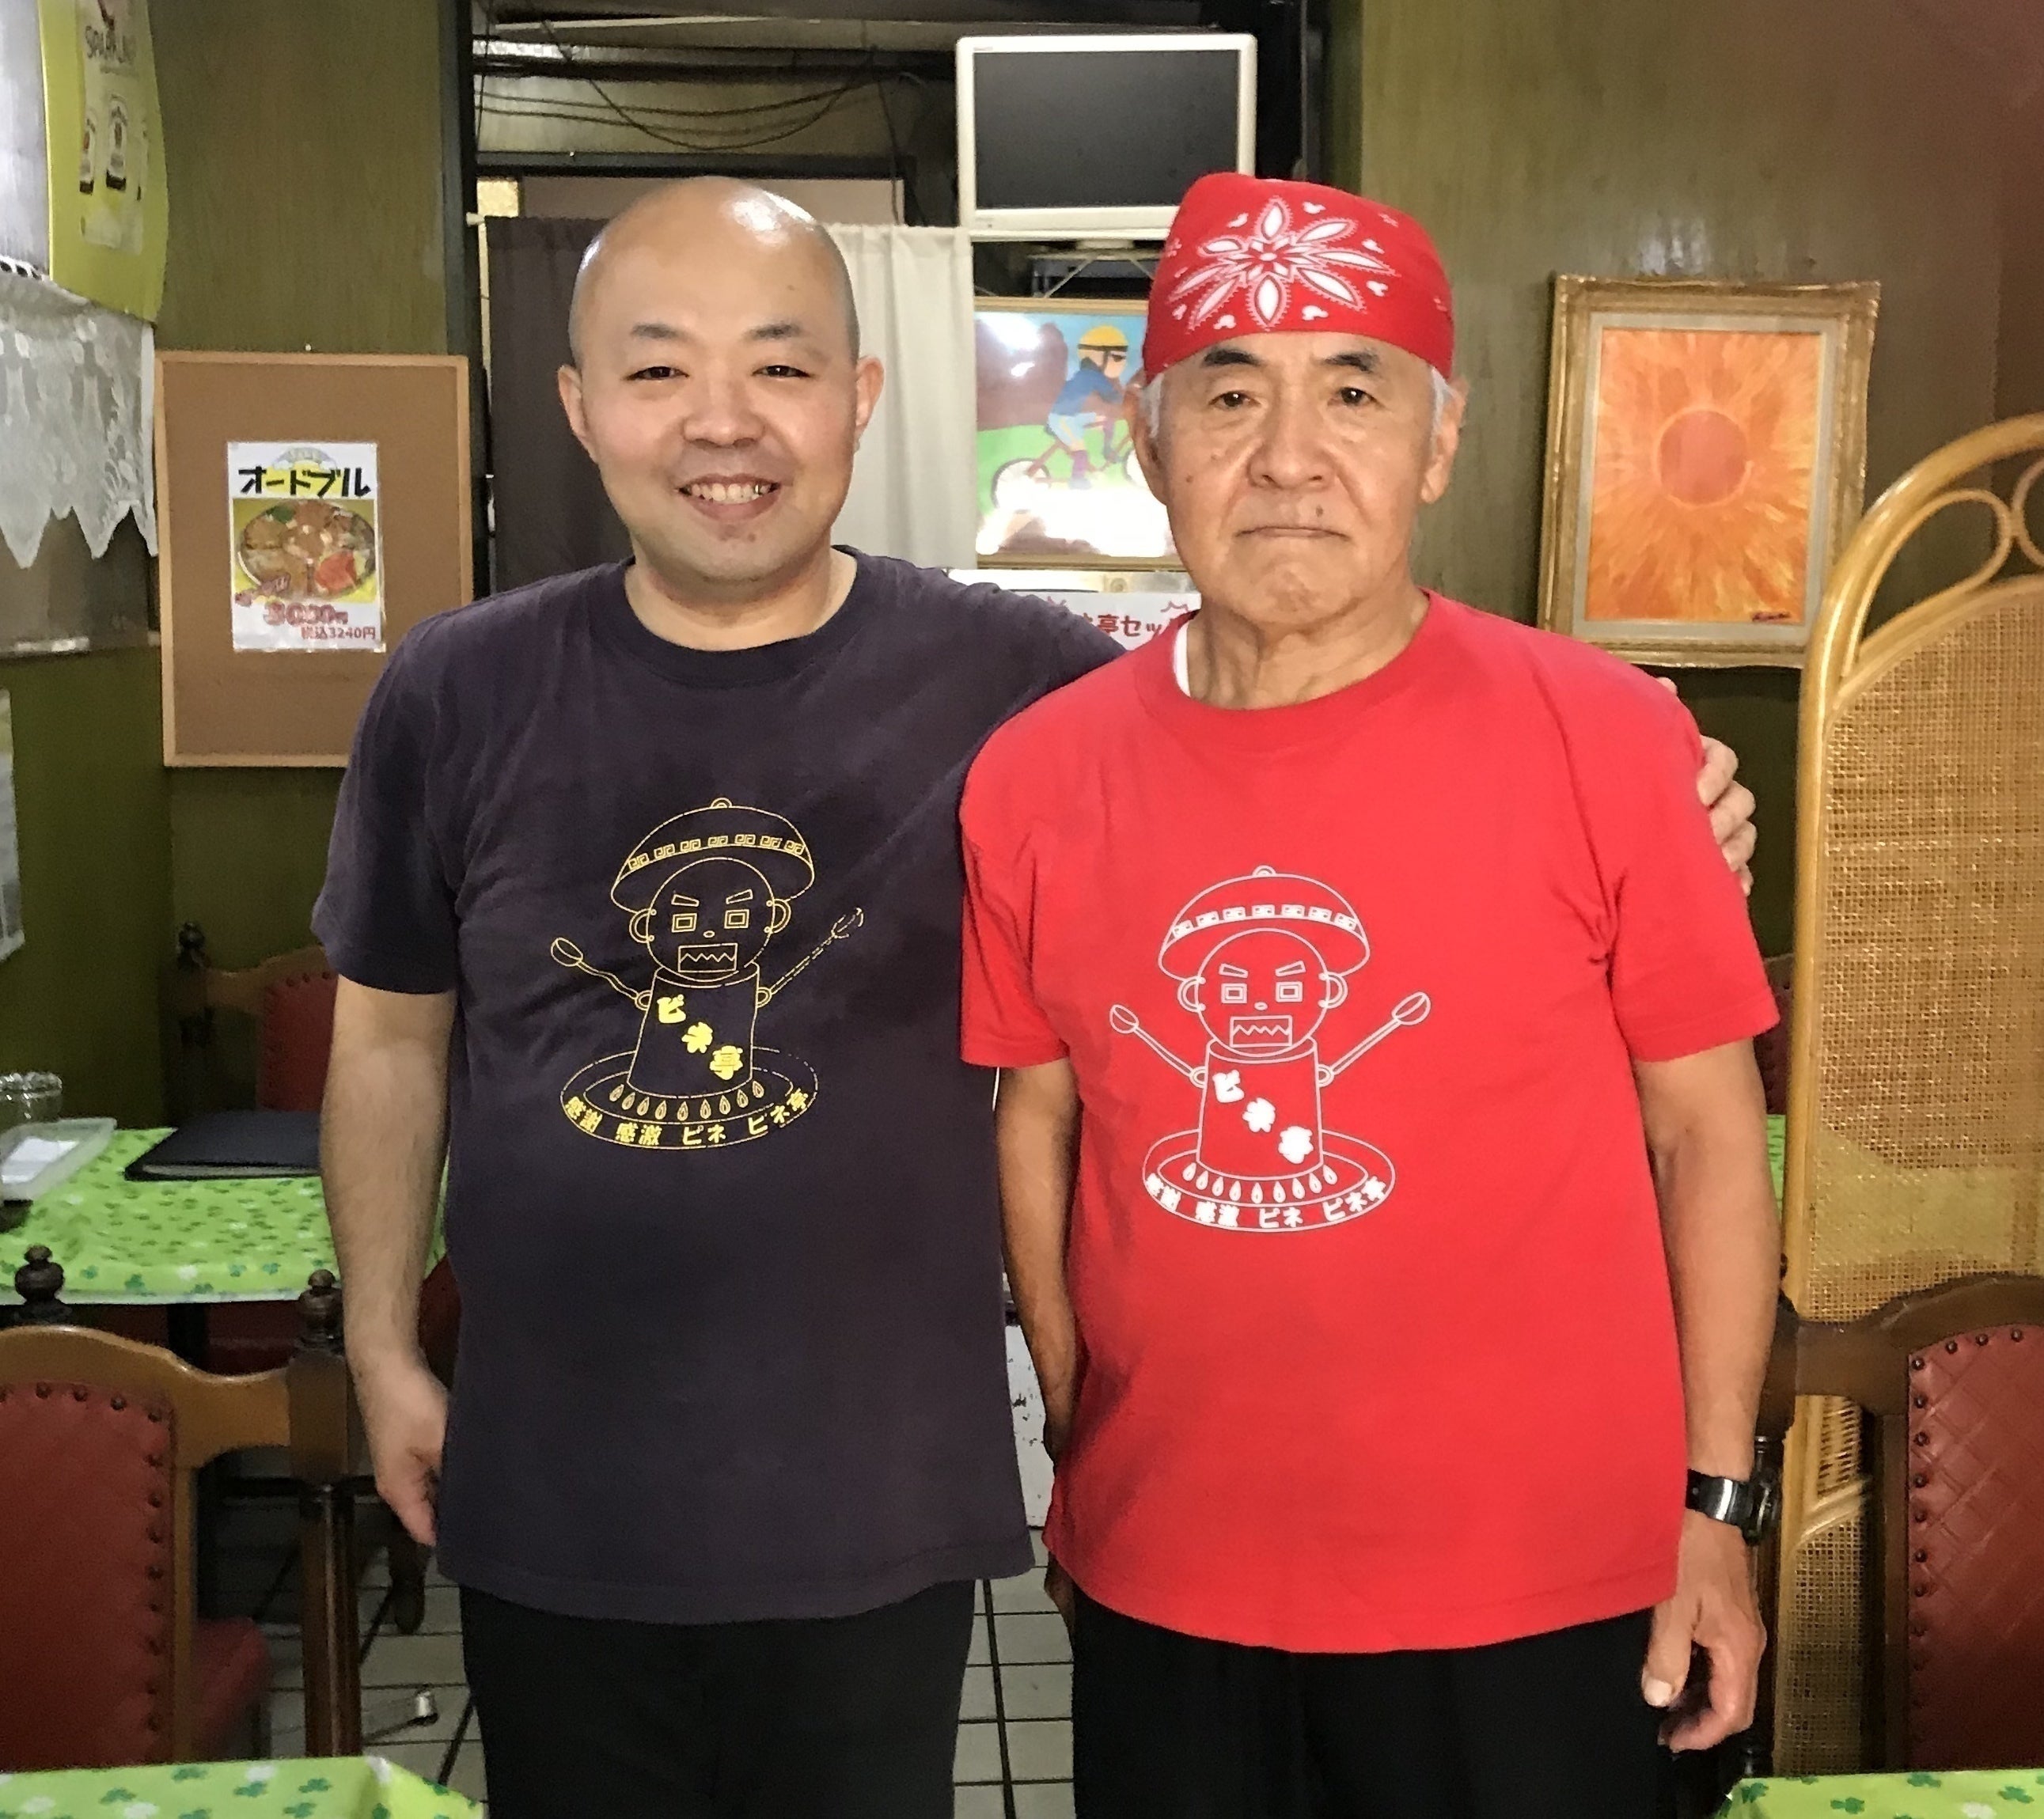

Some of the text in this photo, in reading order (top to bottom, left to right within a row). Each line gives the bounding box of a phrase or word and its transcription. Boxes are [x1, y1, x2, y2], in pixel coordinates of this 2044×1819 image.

[238, 465, 372, 498] オードブル
[1083, 612, 1168, 638] 亭セッ
[682, 1125, 727, 1146] ピネ
[1258, 1207, 1304, 1229] ピネ
